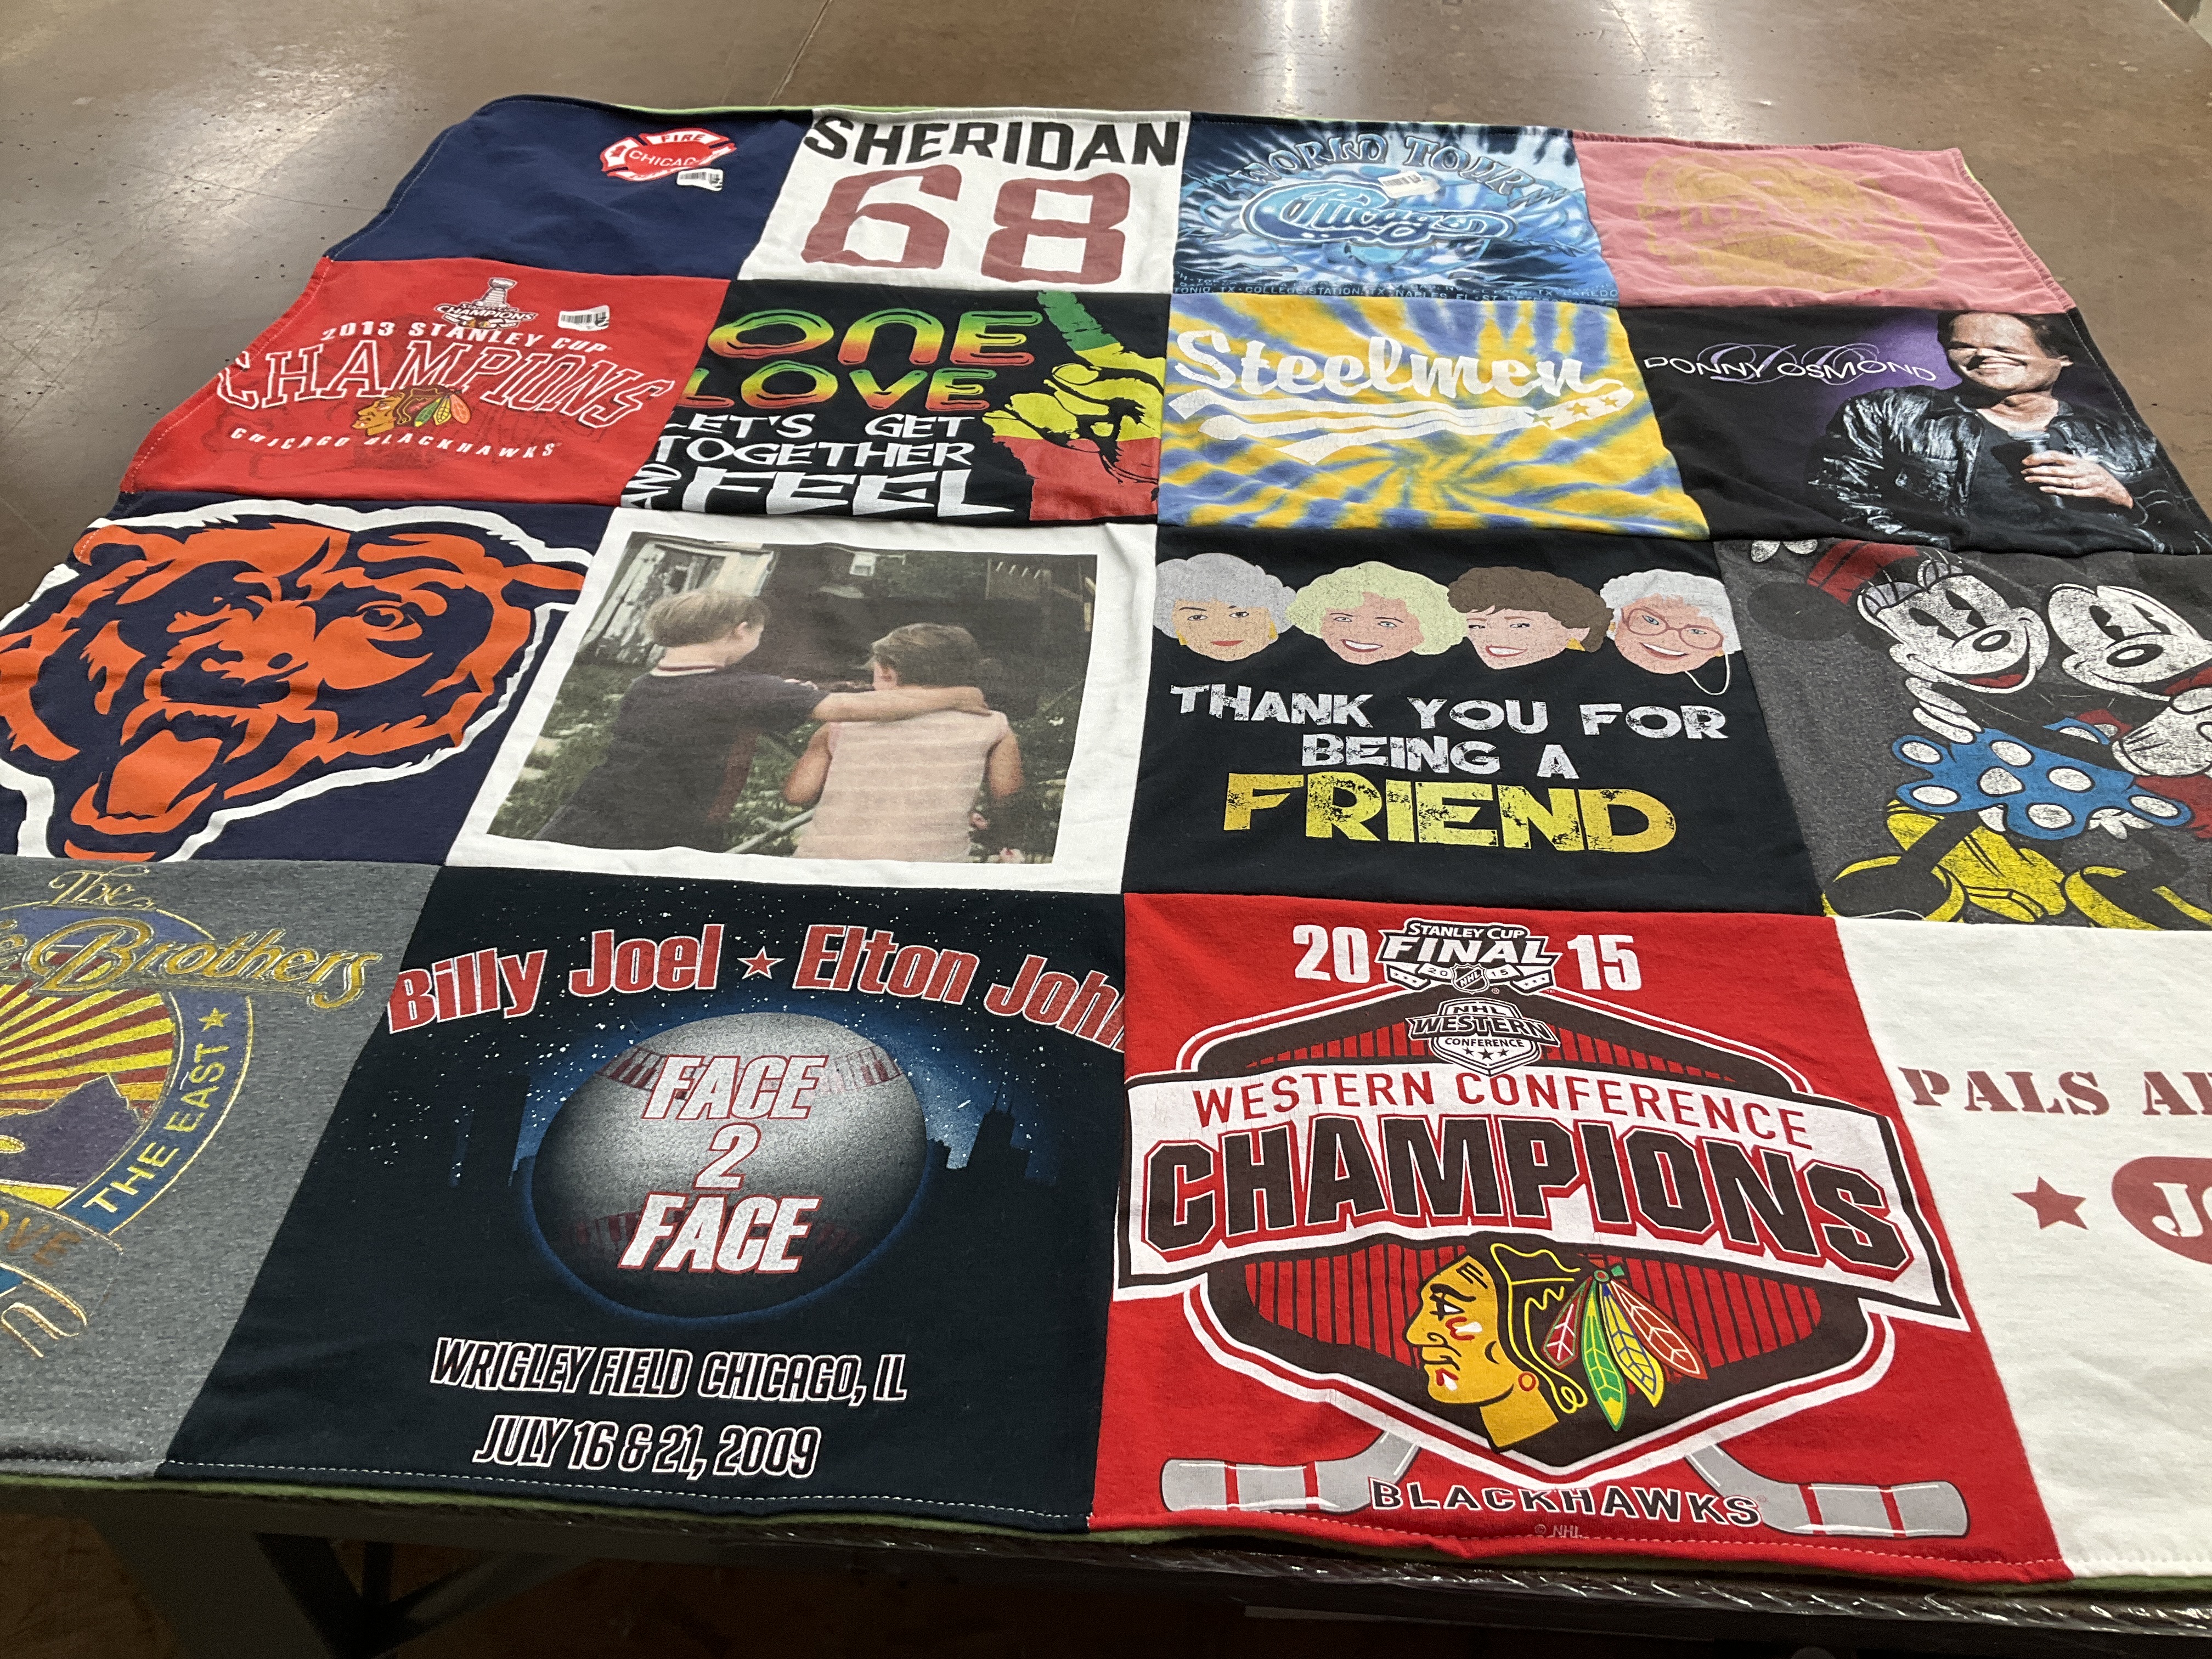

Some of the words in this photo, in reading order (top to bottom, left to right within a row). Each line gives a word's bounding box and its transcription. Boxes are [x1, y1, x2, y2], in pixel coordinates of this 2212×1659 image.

[629, 150, 697, 167] CHICAG
[804, 115, 1180, 171] SHERIDAN
[1228, 133, 1389, 185] WORLD
[1402, 135, 1536, 196] TOUR
[800, 164, 1131, 284] 68
[320, 320, 396, 341] 2013
[408, 321, 545, 347] STANLEY
[551, 337, 608, 353] CUP
[436, 304, 537, 320] CHAMPIONS
[707, 308, 1045, 366] ONE
[217, 339, 676, 430] CHAMPIONS
[678, 359, 997, 411] LOVE
[1174, 330, 1626, 399] Steelmen
[1644, 357, 1765, 379] DONNY
[1777, 360, 1937, 381] OSMOND
[230, 427, 351, 450] CHICAGO
[363, 432, 556, 459] BLACKHAWKS
[655, 435, 977, 468] TOGETHER
[864, 413, 977, 438] GET
[682, 466, 1014, 518] FEEL
[1170, 682, 1374, 729] THANK
[1407, 696, 1549, 735] YOU
[1581, 703, 1729, 740] FOR
[1301, 733, 1500, 775] BEING
[1536, 743, 1579, 779] A
[1223, 771, 1678, 853] FRIEND
[47, 864, 157, 909] The
[1381, 935, 1559, 964] FINAL
[1408, 922, 1485, 939] STANLEY
[1486, 927, 1527, 940] CUP
[22, 917, 383, 1010] Brothers
[386, 947, 550, 1034] Billy
[567, 923, 726, 998] Joel
[791, 924, 981, 1006] Elton
[1292, 924, 1370, 984] 20
[1566, 934, 1643, 991] 15
[1426, 967, 1448, 977] 20
[1459, 969, 1482, 990] NHL
[1413, 1015, 1557, 1042] WESTERN
[1453, 1006, 1508, 1015] NHL
[1444, 1037, 1525, 1048] CONFERENCE
[641, 1053, 830, 1122] FACE
[1192, 1070, 1435, 1130] WESTERN
[1457, 1071, 1812, 1150] CONFERENCE
[1898, 1066, 2111, 1116] PALS
[82, 1141, 180, 1214] THE
[165, 1043, 230, 1133] EAST
[691, 1121, 763, 1189] 2
[1140, 1113, 1916, 1284] CHAMPIONS
[616, 1193, 823, 1274] FACE
[430, 1336, 594, 1396] WRIGLEY
[589, 1347, 693, 1400] FIELD
[697, 1351, 868, 1408] CHICAGO,
[872, 1353, 909, 1402] IL
[472, 1414, 574, 1469] JULY
[569, 1421, 620, 1472] 16
[618, 1424, 652, 1474] &
[651, 1426, 708, 1482] 21,
[712, 1425, 823, 1480] 2009
[1367, 1476, 1767, 1527] BLACKHAWKS
